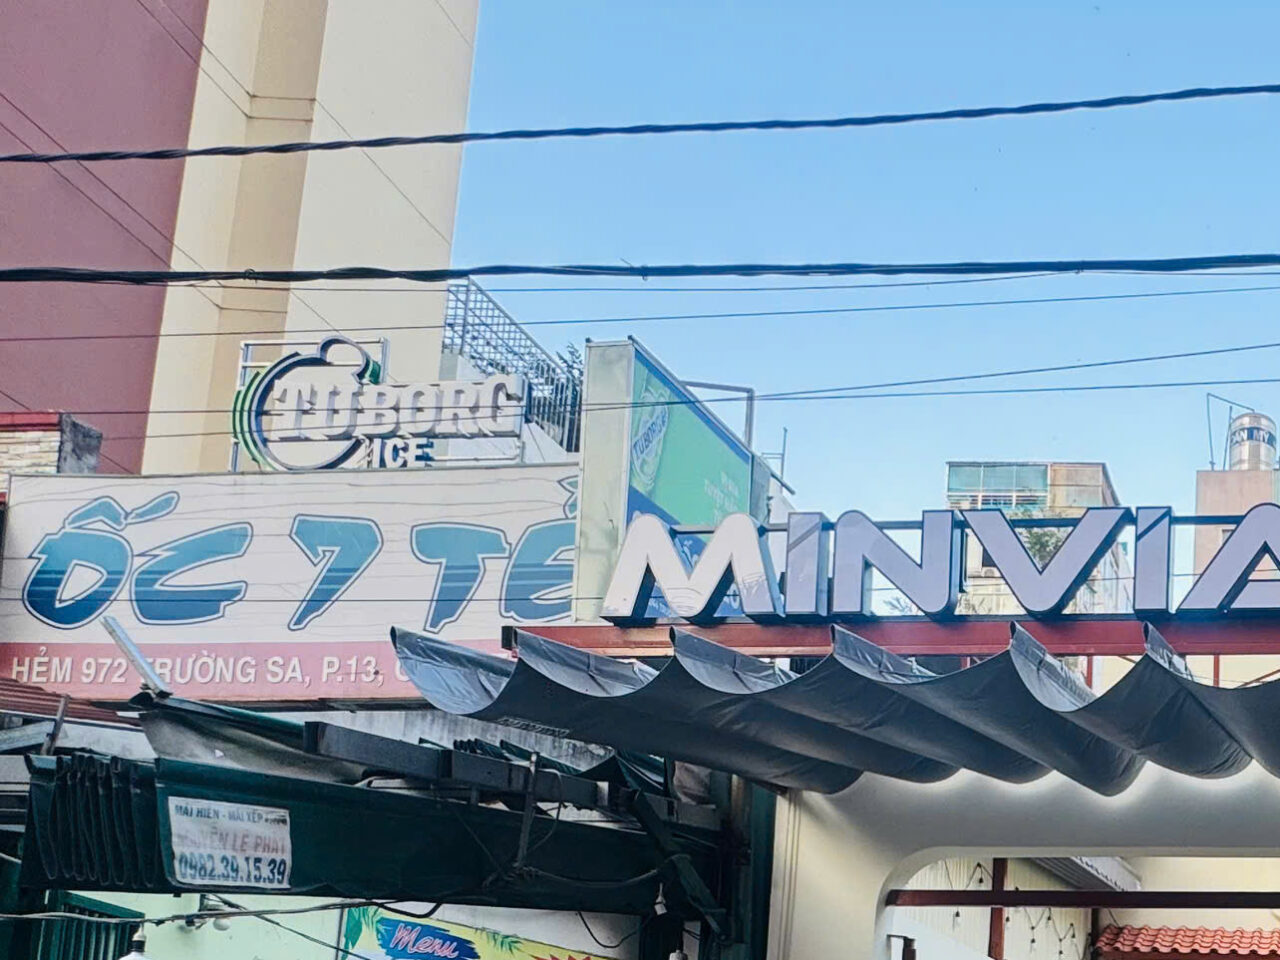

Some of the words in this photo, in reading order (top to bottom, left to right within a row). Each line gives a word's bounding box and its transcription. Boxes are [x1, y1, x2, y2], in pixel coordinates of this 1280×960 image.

[271, 374, 522, 438] TUBORG
[369, 437, 434, 469] ICE
[22, 491, 253, 630] ỐC
[288, 514, 383, 630] 7
[410, 476, 578, 633] TẺ
[11, 645, 73, 684] HẺM
[81, 656, 128, 684] 972
[141, 649, 256, 685] RƯỜNG
[266, 656, 311, 688] SA,
[321, 654, 385, 688] P.13,
[390, 923, 459, 958] Menu
